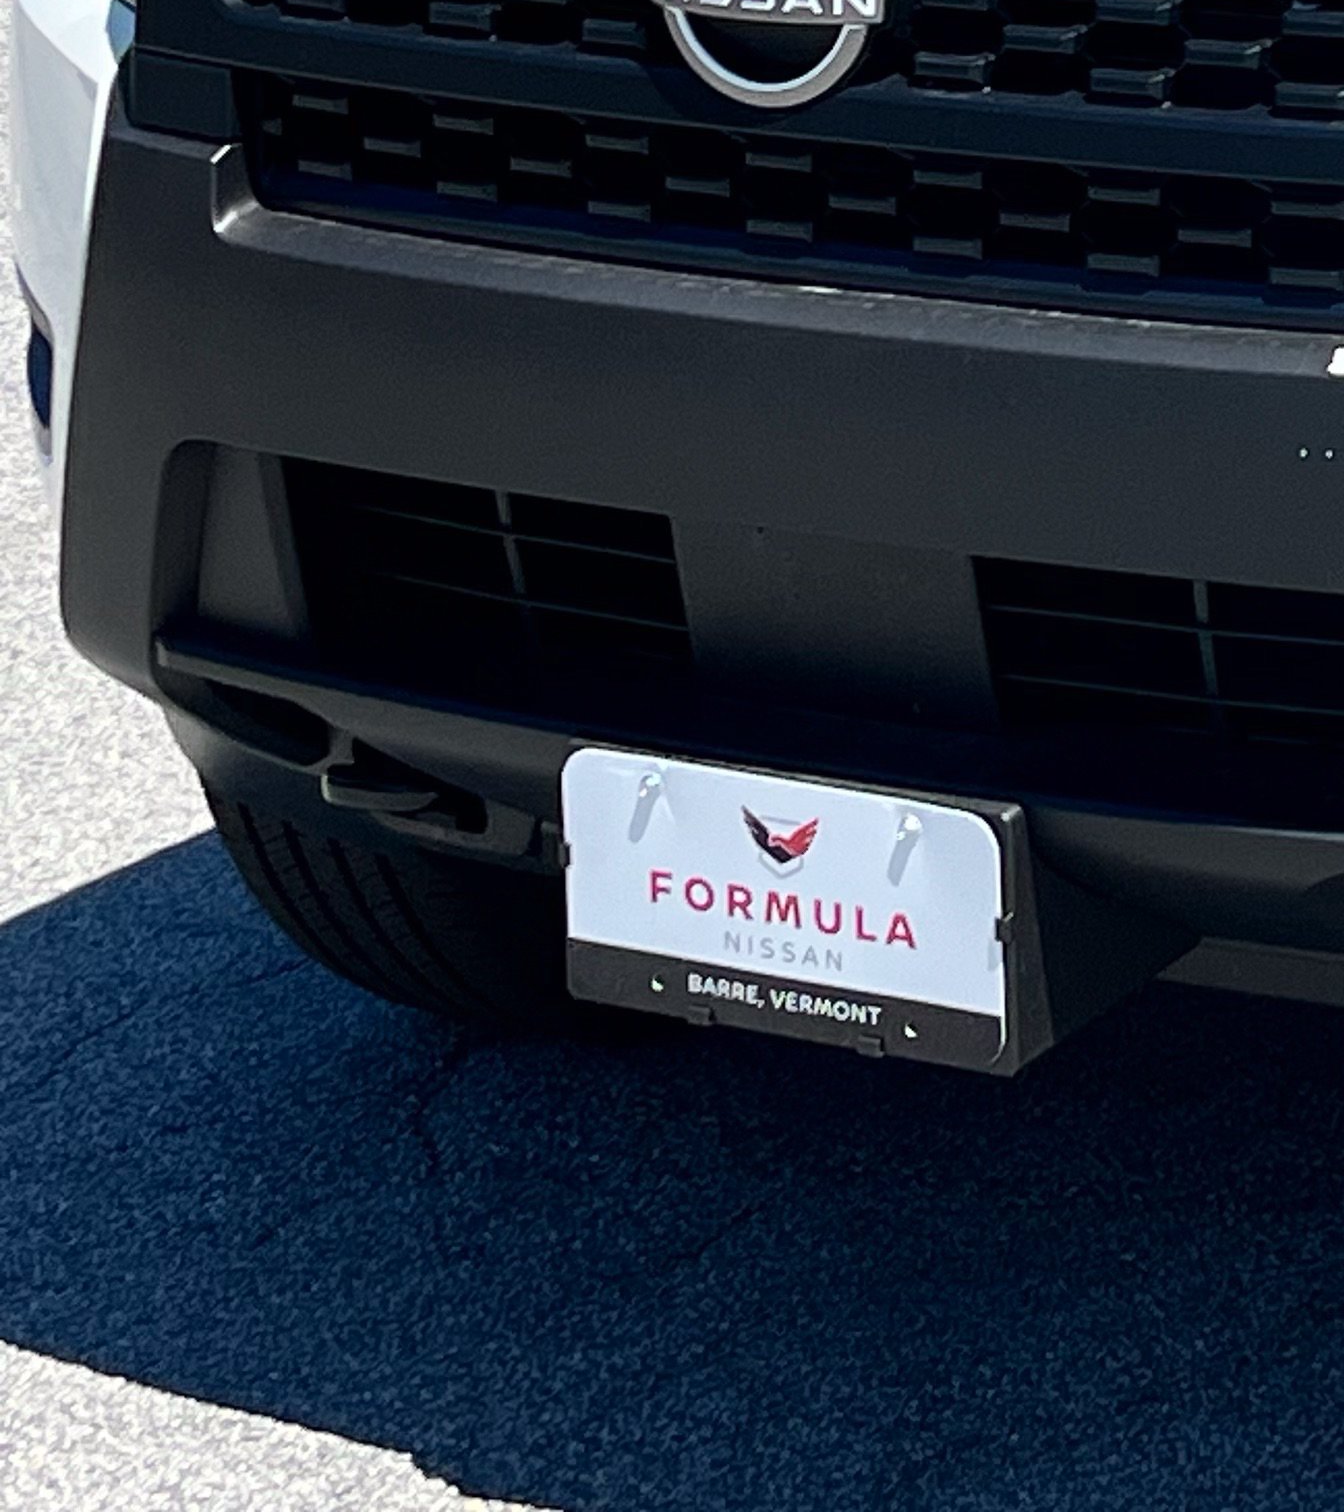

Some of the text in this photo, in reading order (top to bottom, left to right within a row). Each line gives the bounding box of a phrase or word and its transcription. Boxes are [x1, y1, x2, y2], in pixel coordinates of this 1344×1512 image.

[649, 868, 917, 950] FORMULA
[723, 930, 843, 972] NISSAN
[687, 972, 883, 1026] BARRE, VERMONT
